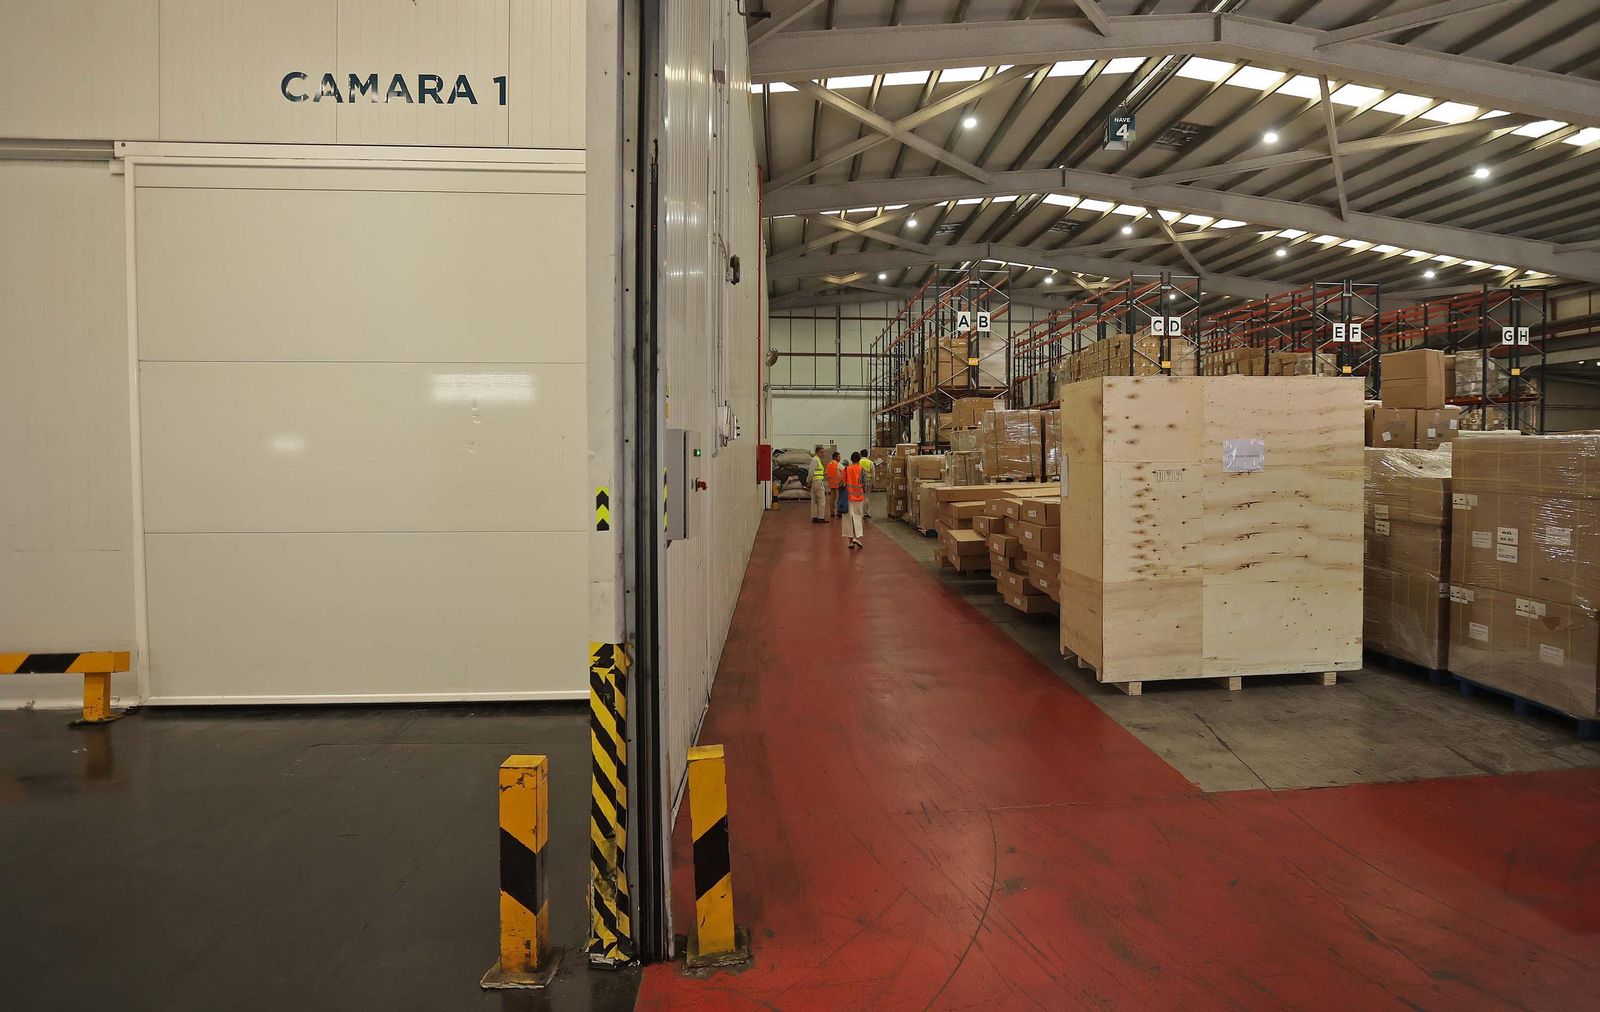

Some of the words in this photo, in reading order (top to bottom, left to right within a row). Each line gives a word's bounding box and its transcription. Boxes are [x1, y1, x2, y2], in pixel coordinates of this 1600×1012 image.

[280, 71, 478, 105] CAMARA
[493, 76, 507, 106] 1
[1116, 123, 1130, 140] 4
[959, 314, 969, 328] A
[978, 315, 989, 328] B
[1153, 320, 1163, 332] C
[1170, 320, 1180, 332] D
[1335, 326, 1343, 339] E
[1352, 327, 1360, 339] F
[1503, 330, 1513, 342] G
[1519, 330, 1528, 342] H
